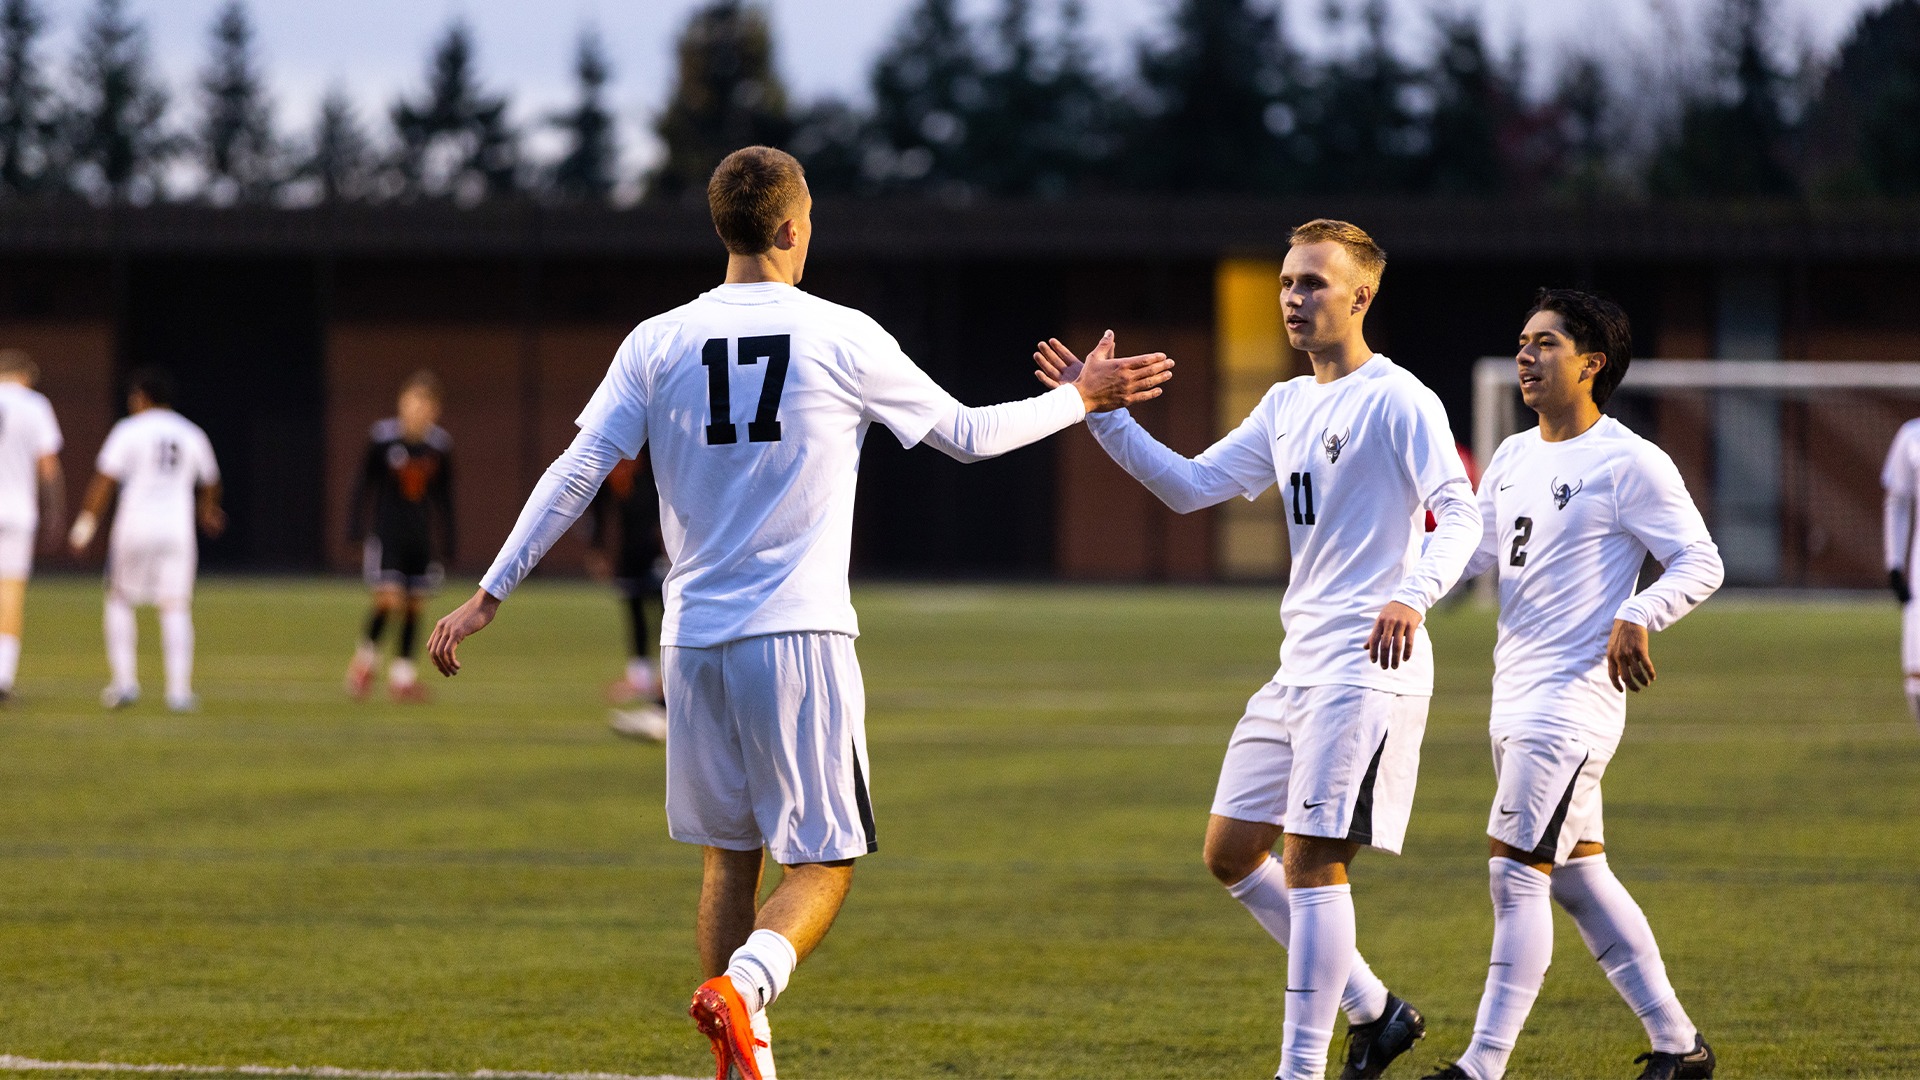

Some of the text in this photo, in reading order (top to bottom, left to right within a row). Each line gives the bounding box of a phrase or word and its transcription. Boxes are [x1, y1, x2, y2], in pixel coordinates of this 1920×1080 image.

[702, 334, 790, 445] 17
[1290, 472, 1315, 525] 11
[1510, 516, 1533, 567] 2
